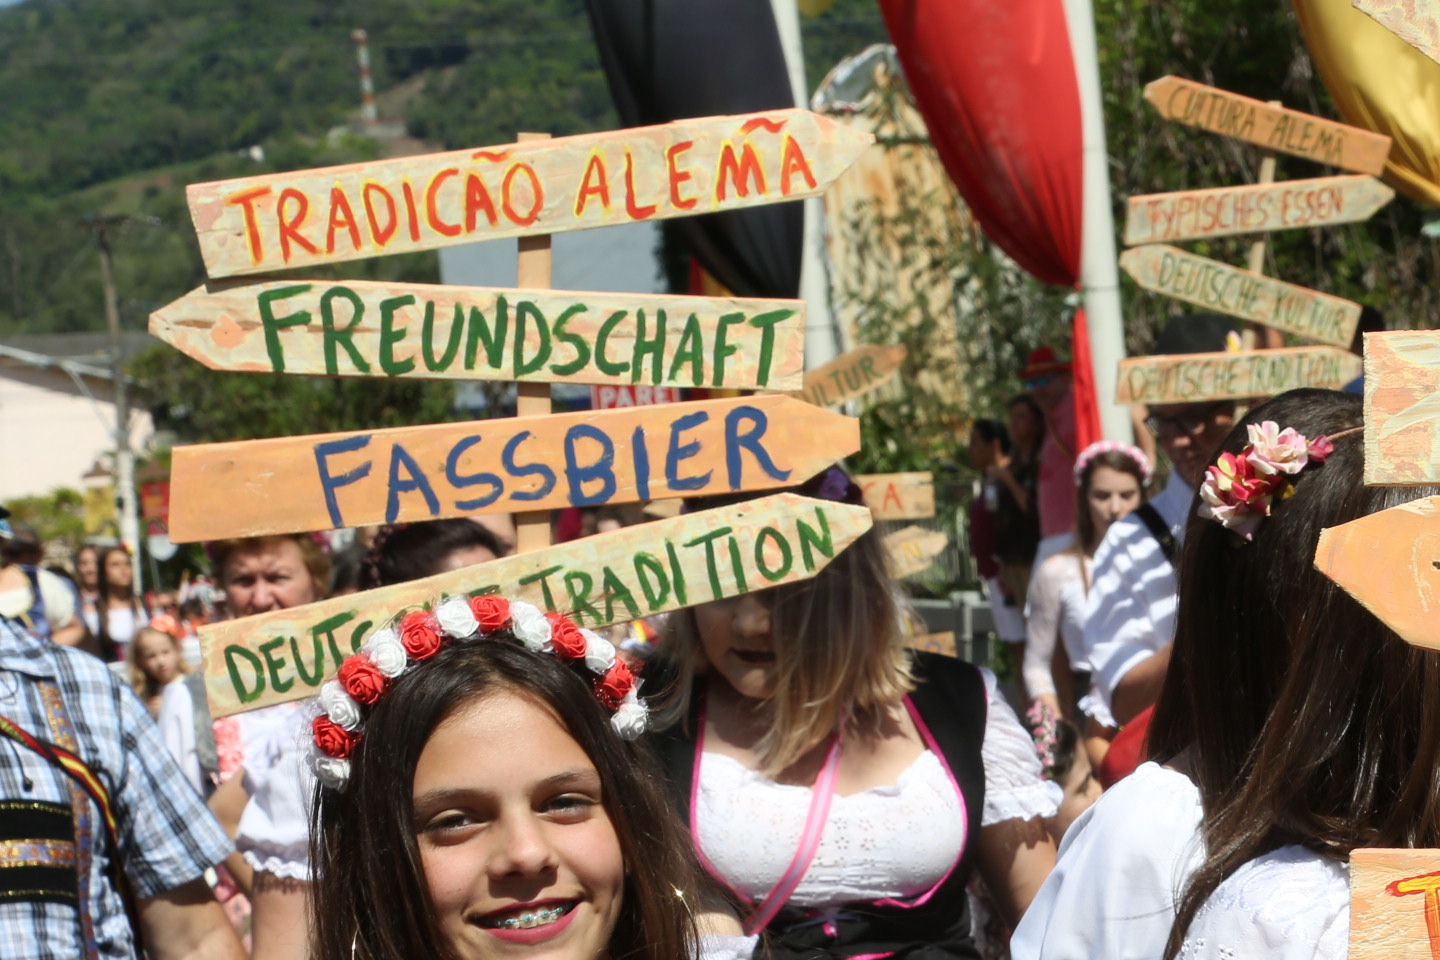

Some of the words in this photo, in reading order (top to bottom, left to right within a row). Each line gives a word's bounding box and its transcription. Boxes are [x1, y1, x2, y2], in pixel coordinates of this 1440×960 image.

[574, 117, 817, 221] ALEMÃ
[256, 284, 796, 386] FREUNDSCHAFT
[313, 404, 794, 528] FASSBIER
